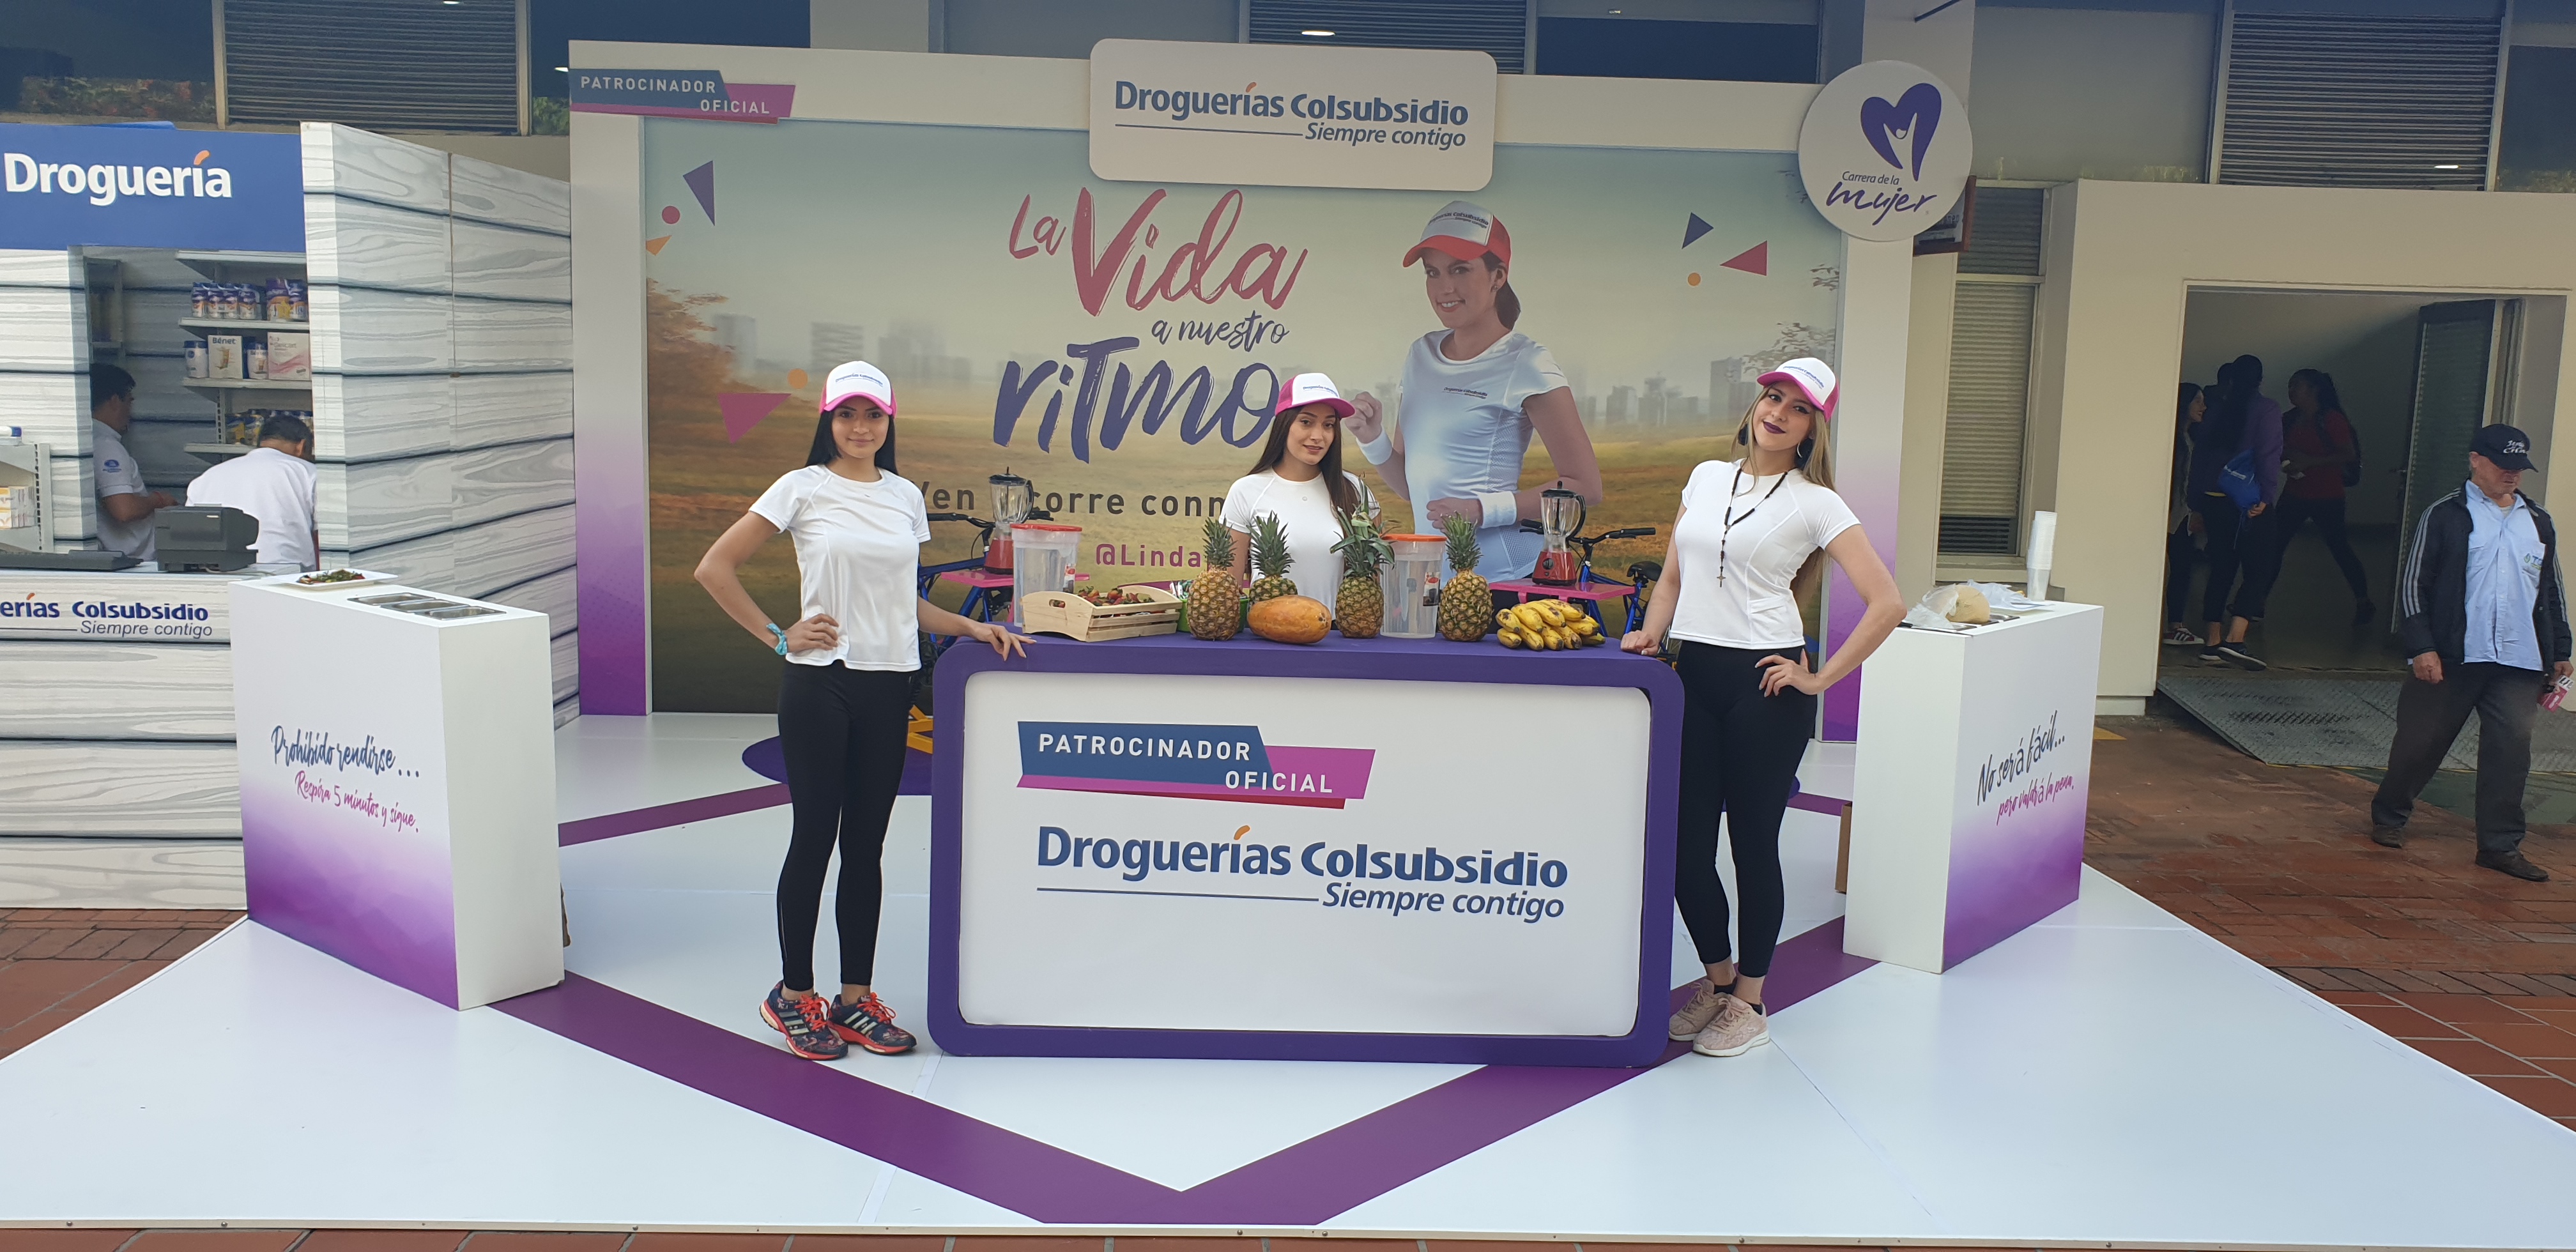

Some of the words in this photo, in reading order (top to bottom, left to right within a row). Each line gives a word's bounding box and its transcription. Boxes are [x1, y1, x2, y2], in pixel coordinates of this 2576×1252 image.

[581, 76, 716, 93] PATROCINADOR
[1116, 82, 1284, 121] Droguerías
[1291, 93, 1468, 126] Colsubsidio
[700, 100, 770, 114] OFICIAL
[1305, 122, 1386, 146] Siempre
[1392, 128, 1466, 151] contigo
[4, 150, 233, 206] Droguería
[1843, 171, 1876, 183] Carrera
[1878, 174, 1889, 185] de
[1890, 175, 1900, 185] la
[1071, 187, 1308, 316] Vida
[1151, 319, 1172, 345] a
[1178, 310, 1289, 352] nuestro
[72, 601, 208, 621] Colsubsidio
[80, 620, 148, 637] Siempre
[155, 622, 213, 639] contigo
[271, 725, 335, 767] Prohibido
[1039, 734, 1251, 761] PATROCINADOR
[1225, 770, 1333, 794] OFICIAL
[1977, 754, 1997, 806] No
[1997, 737, 2023, 787] será
[295, 770, 331, 803] Respira
[334, 785, 341, 807] 5
[344, 790, 379, 818] minutos
[381, 806, 387, 827] y
[1997, 795, 2018, 826] pero
[2046, 772, 2053, 801] la
[1038, 825, 1291, 882] Droguerías
[1301, 841, 1568, 888] Colsubsidio
[1323, 882, 1444, 917] Siempre
[1453, 890, 1565, 924] contigo
